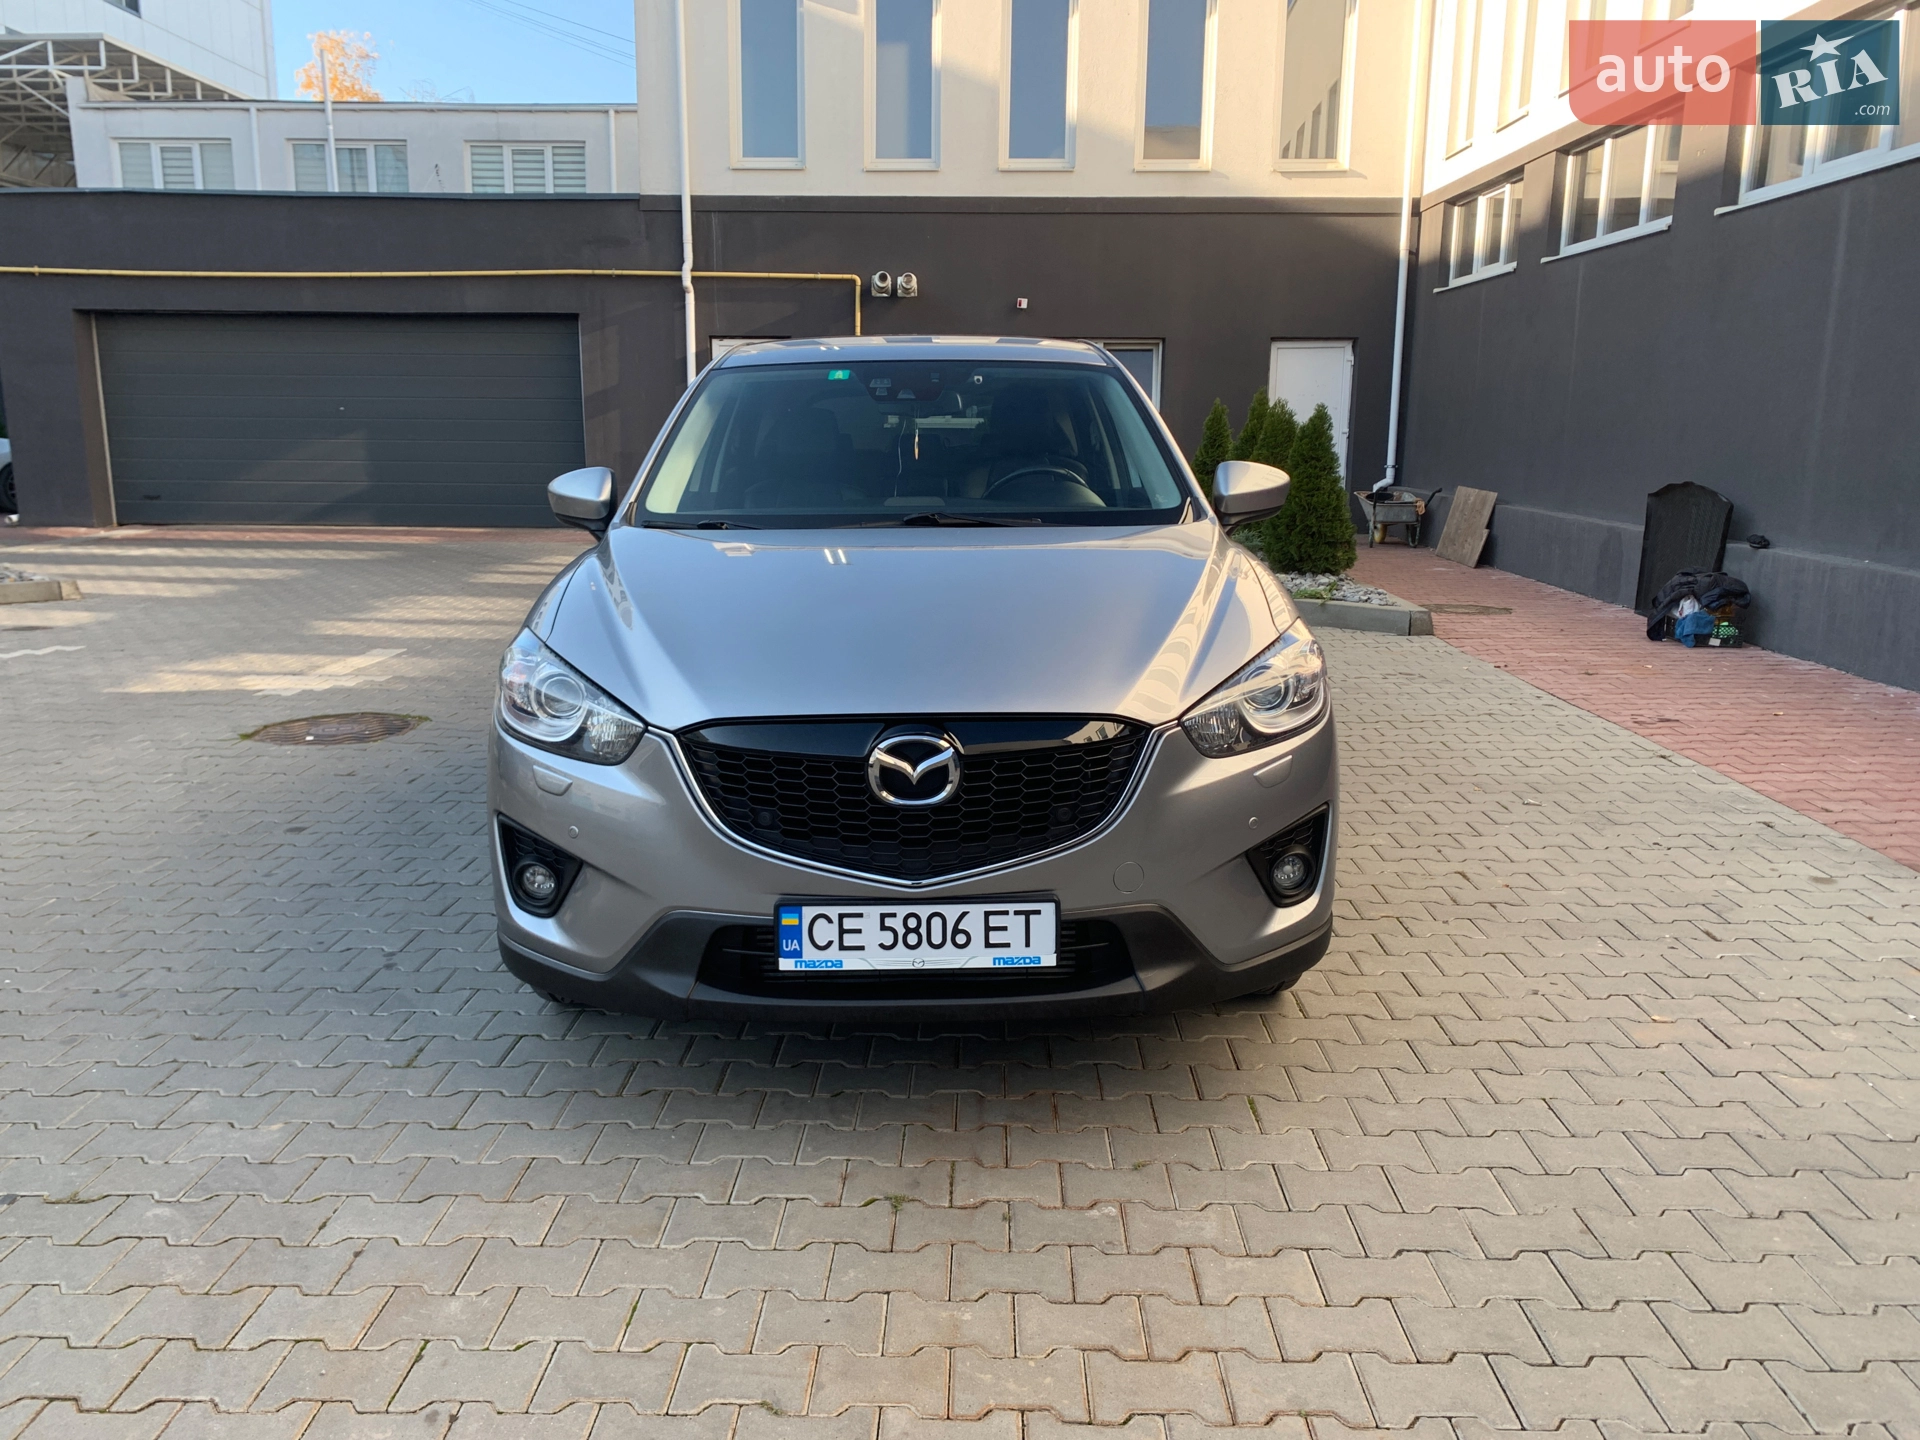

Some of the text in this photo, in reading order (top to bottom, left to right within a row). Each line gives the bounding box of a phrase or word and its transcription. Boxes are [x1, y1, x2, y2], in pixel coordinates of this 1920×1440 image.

[807, 909, 1042, 952] CE 5806 ET
[782, 938, 801, 952] UA
[794, 959, 844, 969] mazda
[992, 956, 1042, 966] mazda
